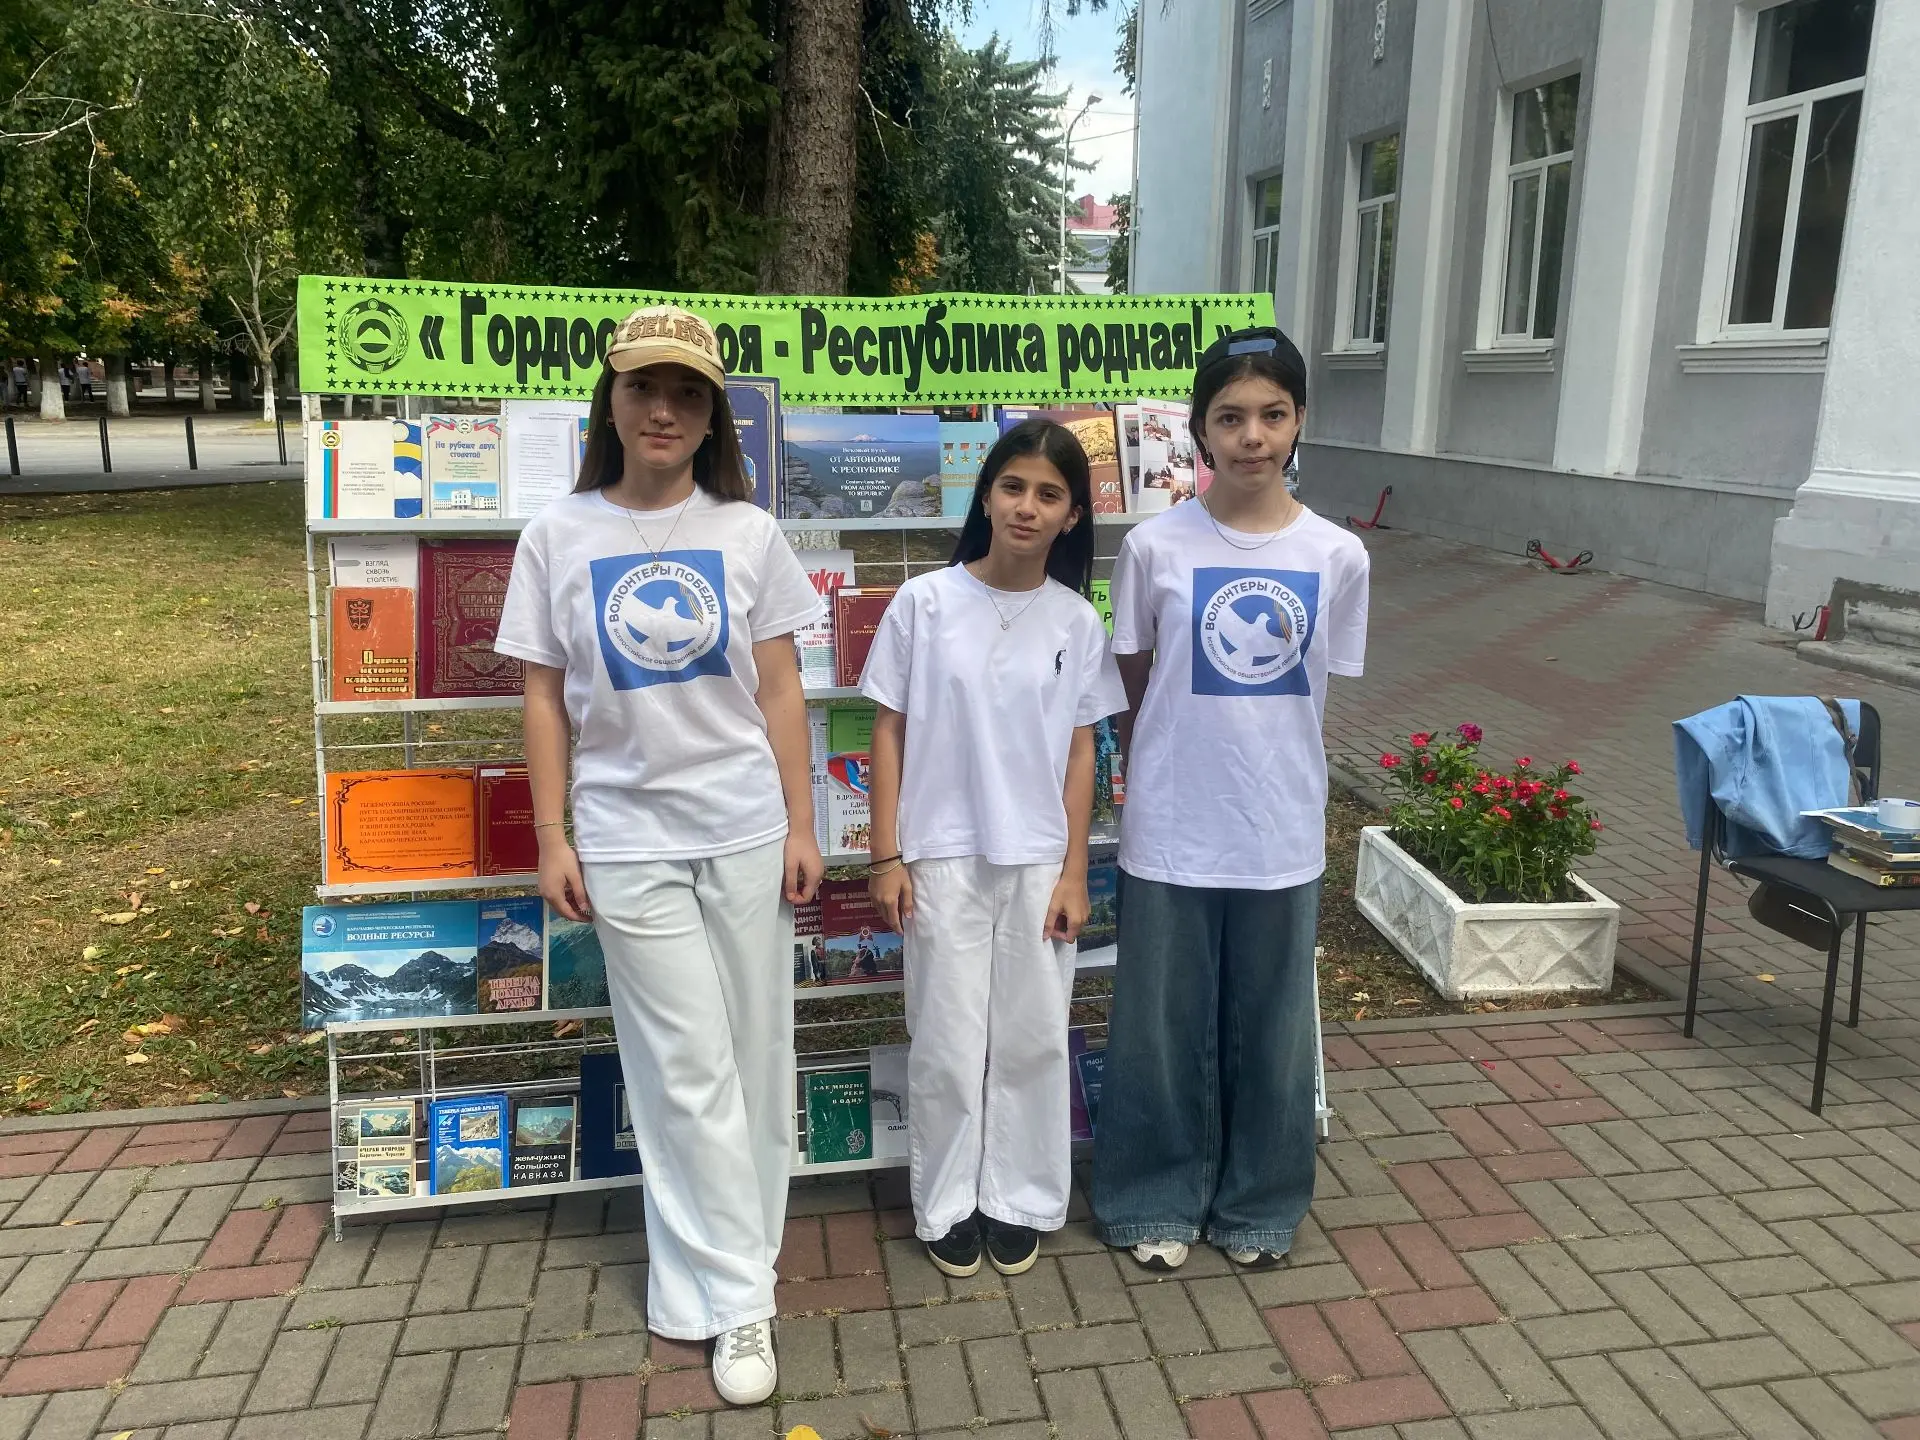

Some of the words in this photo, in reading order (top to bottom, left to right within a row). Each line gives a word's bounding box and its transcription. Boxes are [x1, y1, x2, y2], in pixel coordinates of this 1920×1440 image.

[460, 294, 617, 385] Гордос
[715, 322, 763, 375] оя
[800, 304, 1048, 393] Республика
[1056, 302, 1203, 389] родная!
[627, 316, 713, 356] SELECT
[831, 466, 839, 474] К
[840, 466, 900, 474] РЕСПУБЛИКЕ
[844, 455, 901, 464] АВТОНОМИИ
[609, 566, 671, 623] ВОЛОНТЕРЫ
[675, 567, 718, 615] ПОБЕДЫ
[1205, 581, 1268, 631] ВОЛОНТЕРЫ
[1270, 585, 1305, 635] ПОБЕДЫ
[613, 628, 653, 664] ВСЕРОССИЙСКОЕ
[654, 648, 698, 666] ОБЩЕСТВЕННОЕ
[1207, 636, 1237, 675] ВСЕРОССИЙСКОЕ
[1237, 664, 1281, 679] ОБЩЕСТВЕННОЕ
[347, 932, 389, 941] ВОДНЫЕ
[391, 930, 435, 939] РЕСУРСЫ
[514, 1162, 560, 1170] большого
[515, 1154, 566, 1163] жемчужина
[513, 1171, 564, 1180] КАВКАЗА
